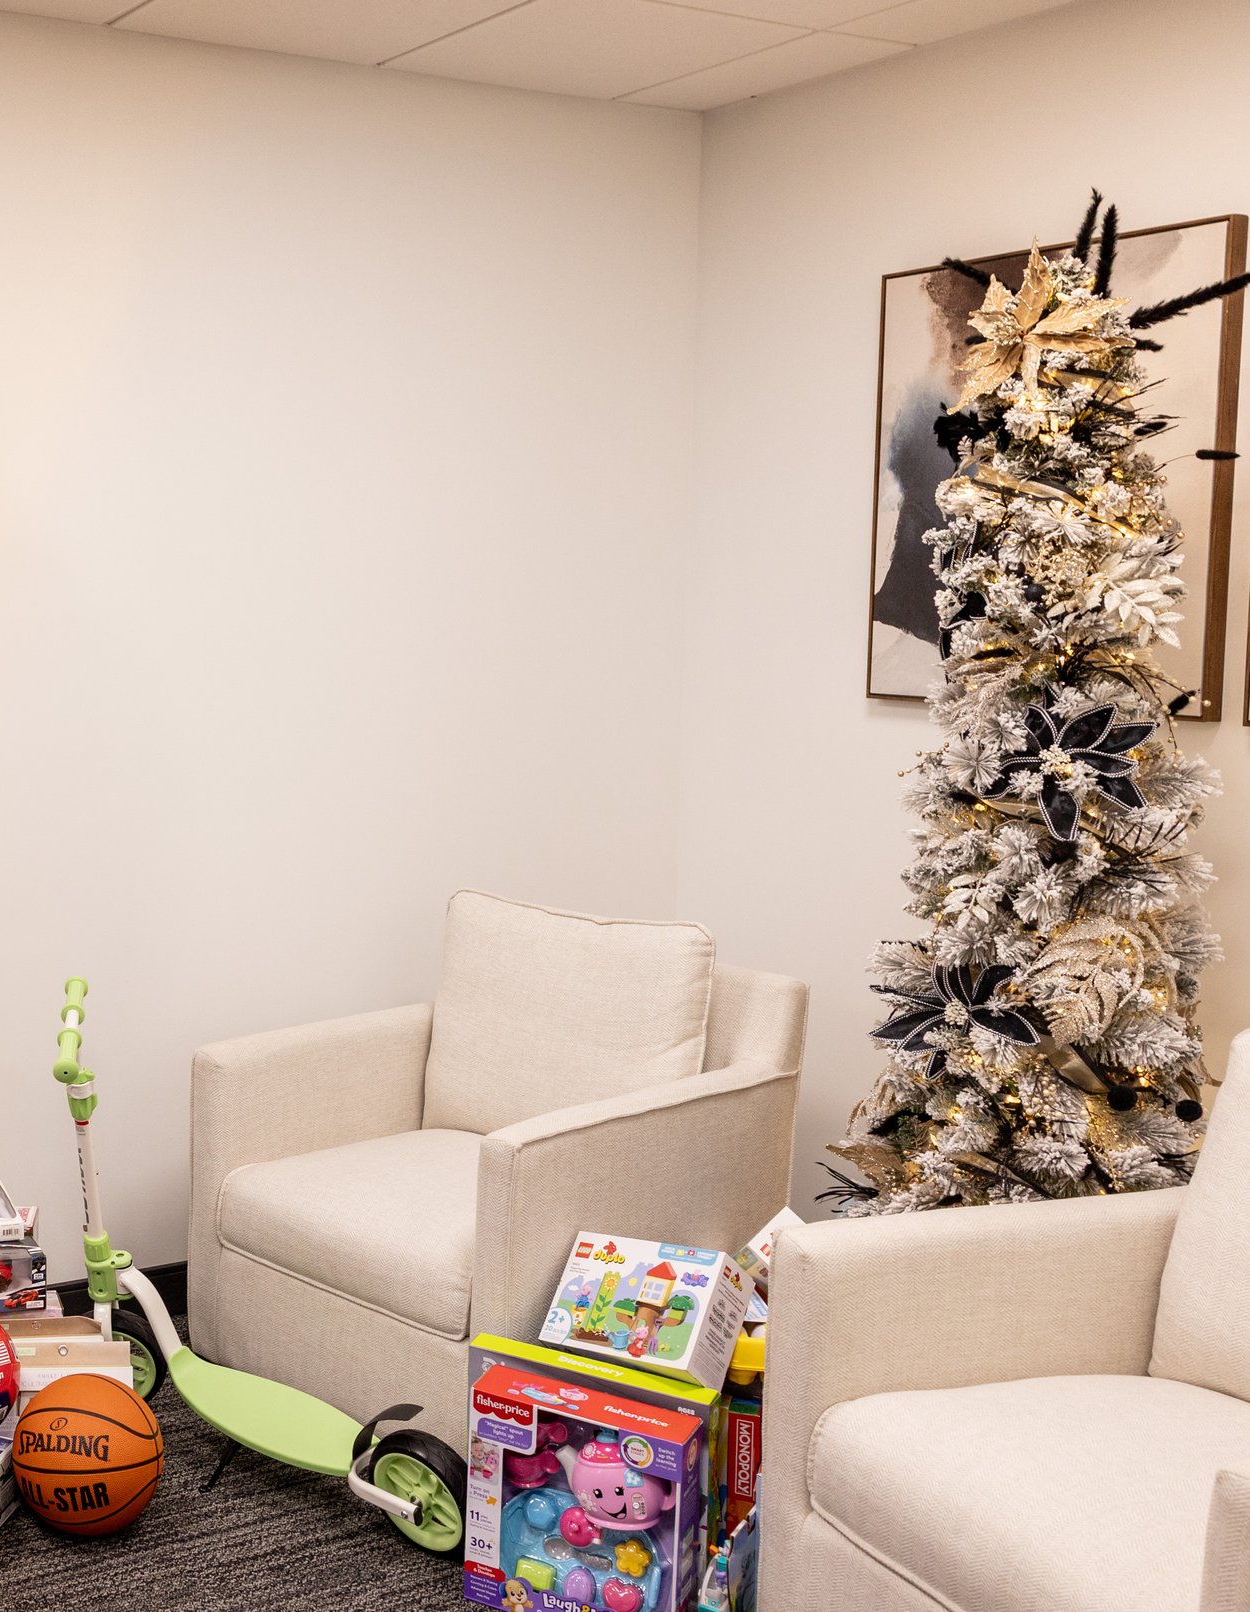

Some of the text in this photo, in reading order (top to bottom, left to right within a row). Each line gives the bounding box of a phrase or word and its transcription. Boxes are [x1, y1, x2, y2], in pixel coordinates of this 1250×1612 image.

[593, 1250, 625, 1264] duplo
[548, 1311, 565, 1324] 2+
[557, 1355, 624, 1378] Discovery
[18, 1430, 109, 1462] SPALDING
[738, 1423, 750, 1494] MONOPOLY
[21, 1476, 110, 1512] ALL-STAR
[470, 1510, 479, 1521] 11
[470, 1536, 492, 1550] 30+
[542, 1593, 581, 1612] Laugh
